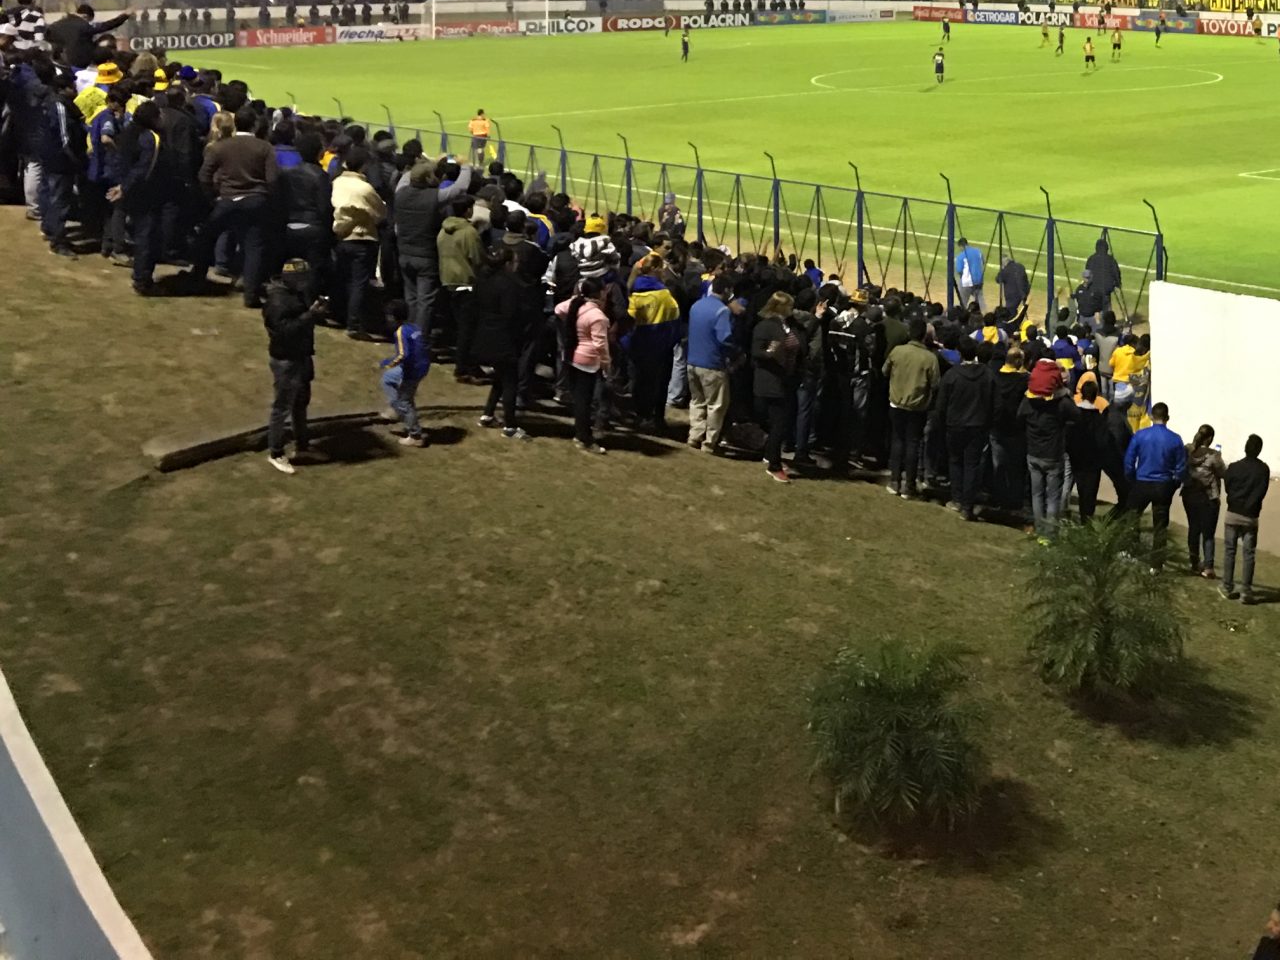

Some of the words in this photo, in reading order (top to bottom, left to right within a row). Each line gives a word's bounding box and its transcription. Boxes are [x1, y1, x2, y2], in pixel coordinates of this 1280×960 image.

[680, 13, 750, 29] POLACRIN
[975, 11, 1017, 23] CETROGAR
[1018, 11, 1070, 26] POLACRIN
[1200, 18, 1256, 35] TOYOTA
[130, 32, 235, 51] CREDICOOP
[256, 28, 318, 46] Schneider
